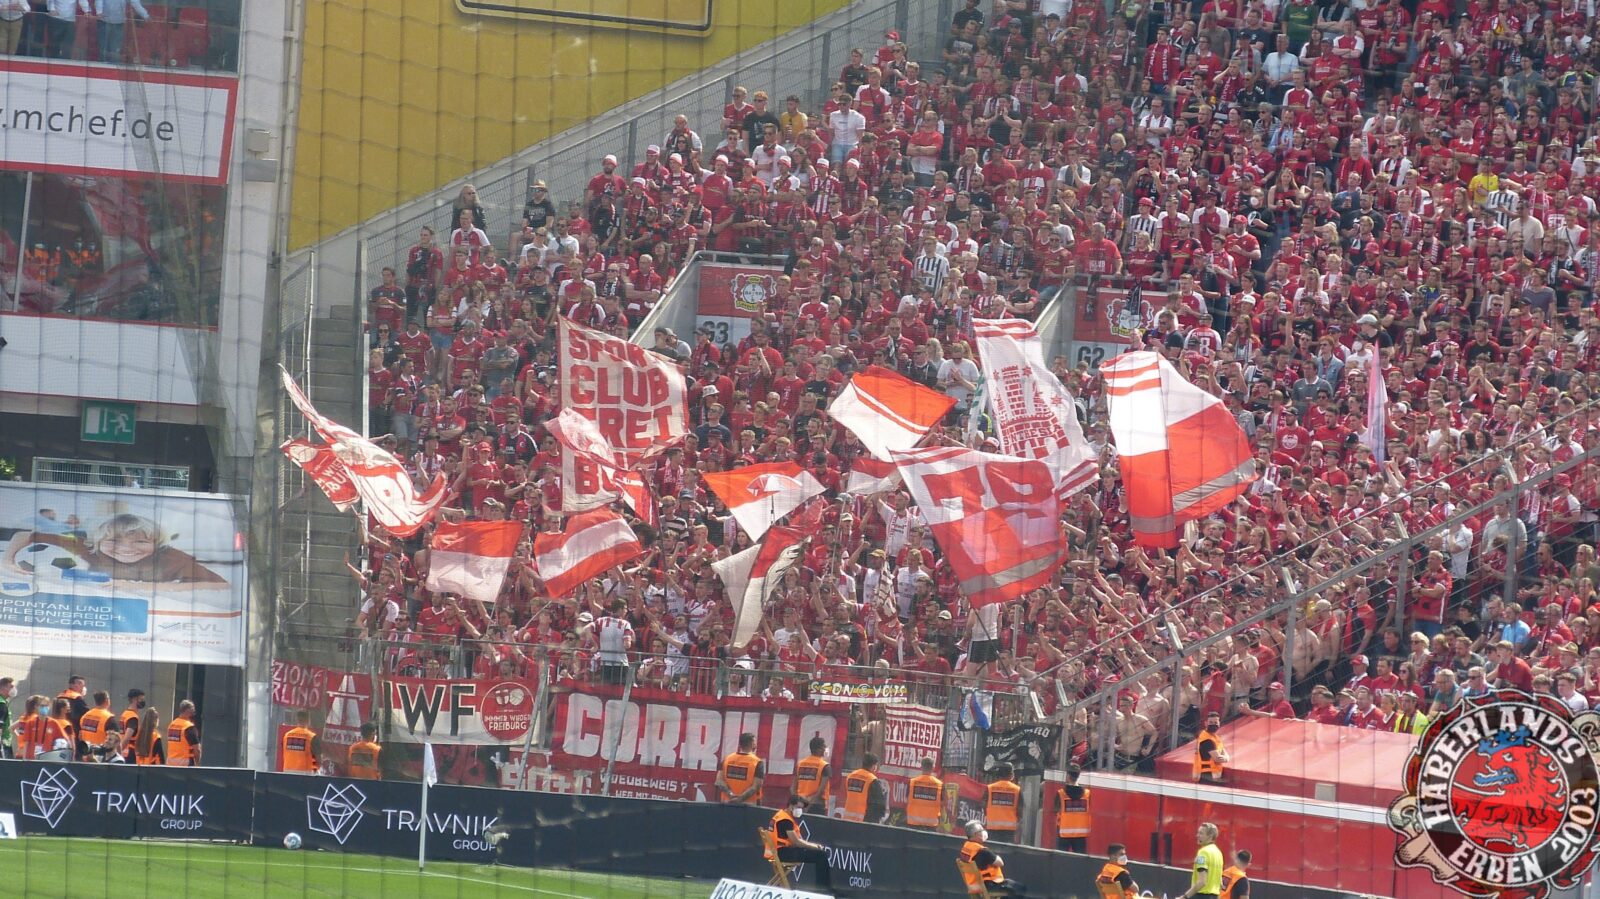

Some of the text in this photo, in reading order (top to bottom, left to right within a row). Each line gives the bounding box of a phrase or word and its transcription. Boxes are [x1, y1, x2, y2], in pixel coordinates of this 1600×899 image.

[0, 106, 174, 141] .mchef.de
[568, 328, 649, 368] SPOR
[1077, 346, 1105, 369] G2
[570, 364, 670, 407] CLUB
[0, 598, 112, 613] PONTAN UND
[0, 605, 126, 621] RLEBNISREICH:
[181, 621, 225, 634] EVL
[272, 660, 324, 688] ZIONE
[272, 681, 320, 708] RLINO
[382, 681, 476, 736] IWF
[488, 721, 528, 731] FREIBURG
[92, 791, 204, 816] TRAVNIK
[160, 818, 203, 831] GROUP
[382, 809, 499, 836] TRAVNIK
[821, 846, 873, 874] RAVNIK
[849, 875, 872, 889] GROUP
